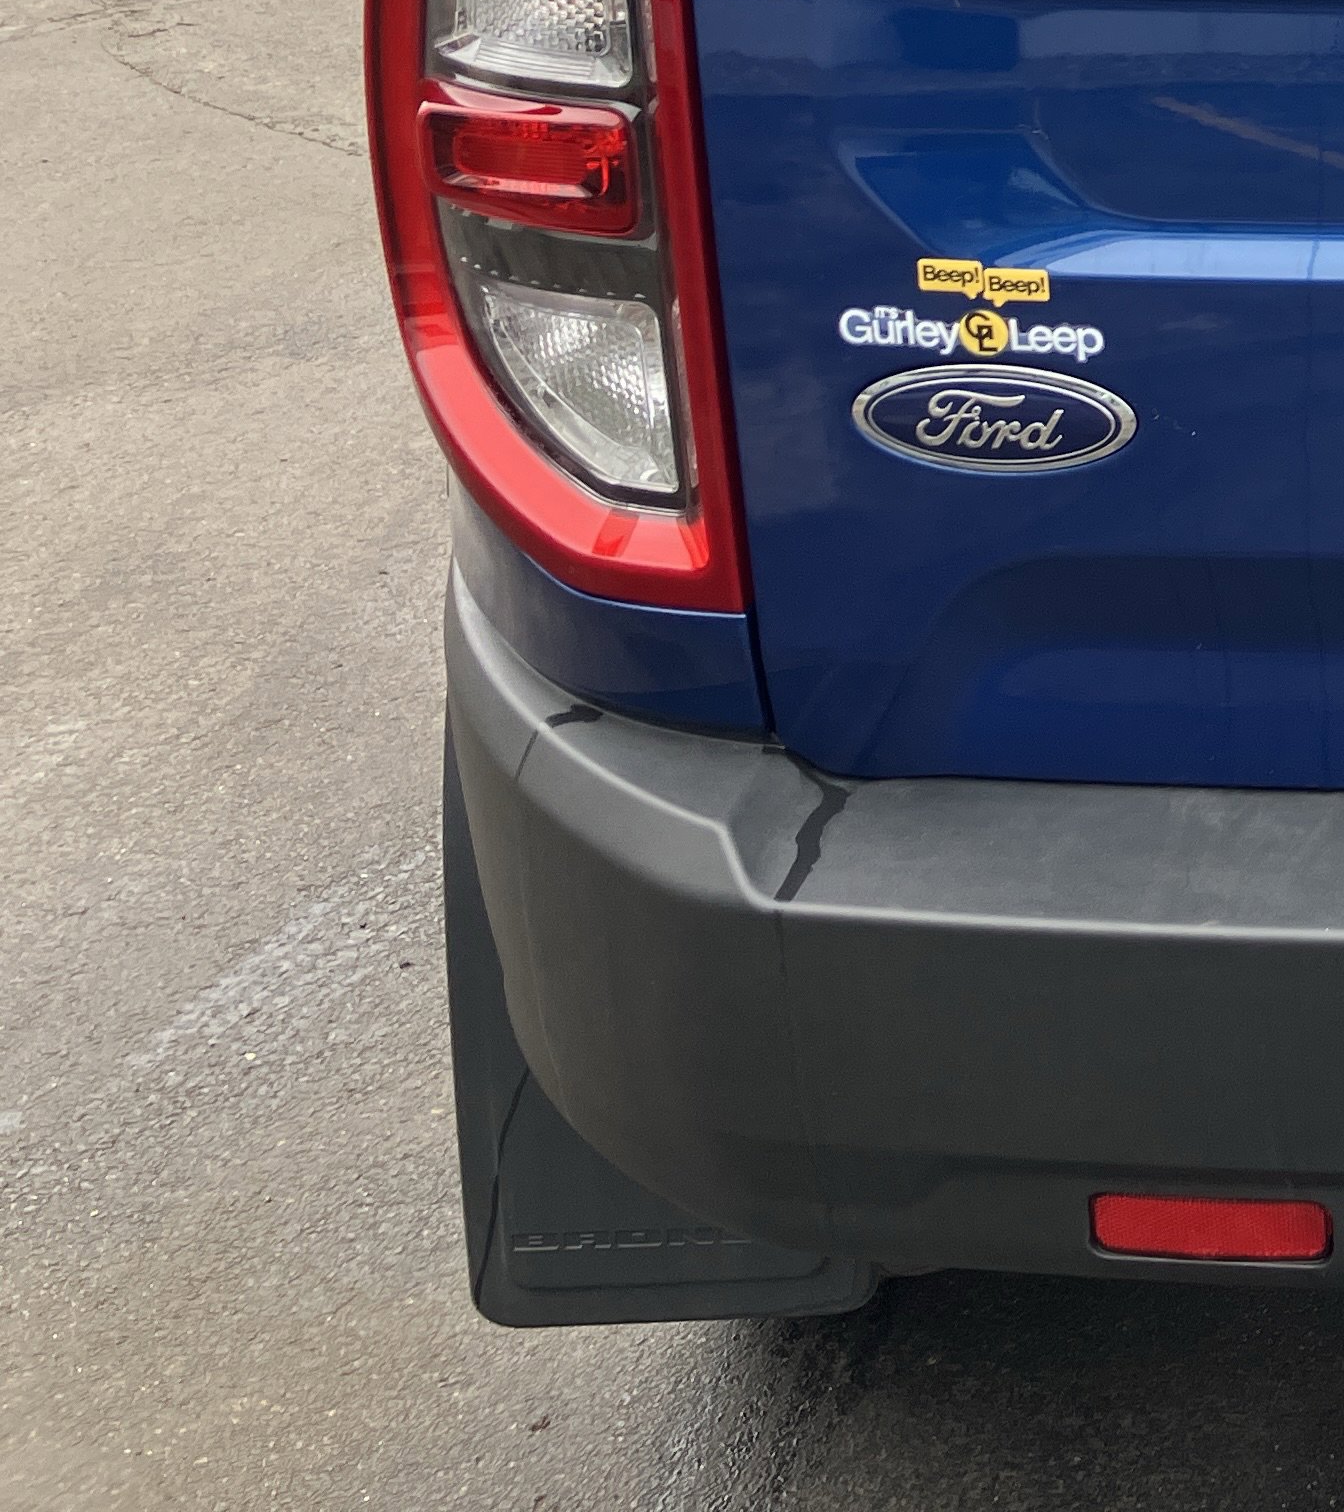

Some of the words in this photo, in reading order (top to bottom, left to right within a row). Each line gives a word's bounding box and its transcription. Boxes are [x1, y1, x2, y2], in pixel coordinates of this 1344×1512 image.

[921, 265, 981, 285] Beep!
[988, 276, 1045, 297] Beep!
[1010, 319, 1104, 362] Leep
[916, 389, 1065, 450] Ford
